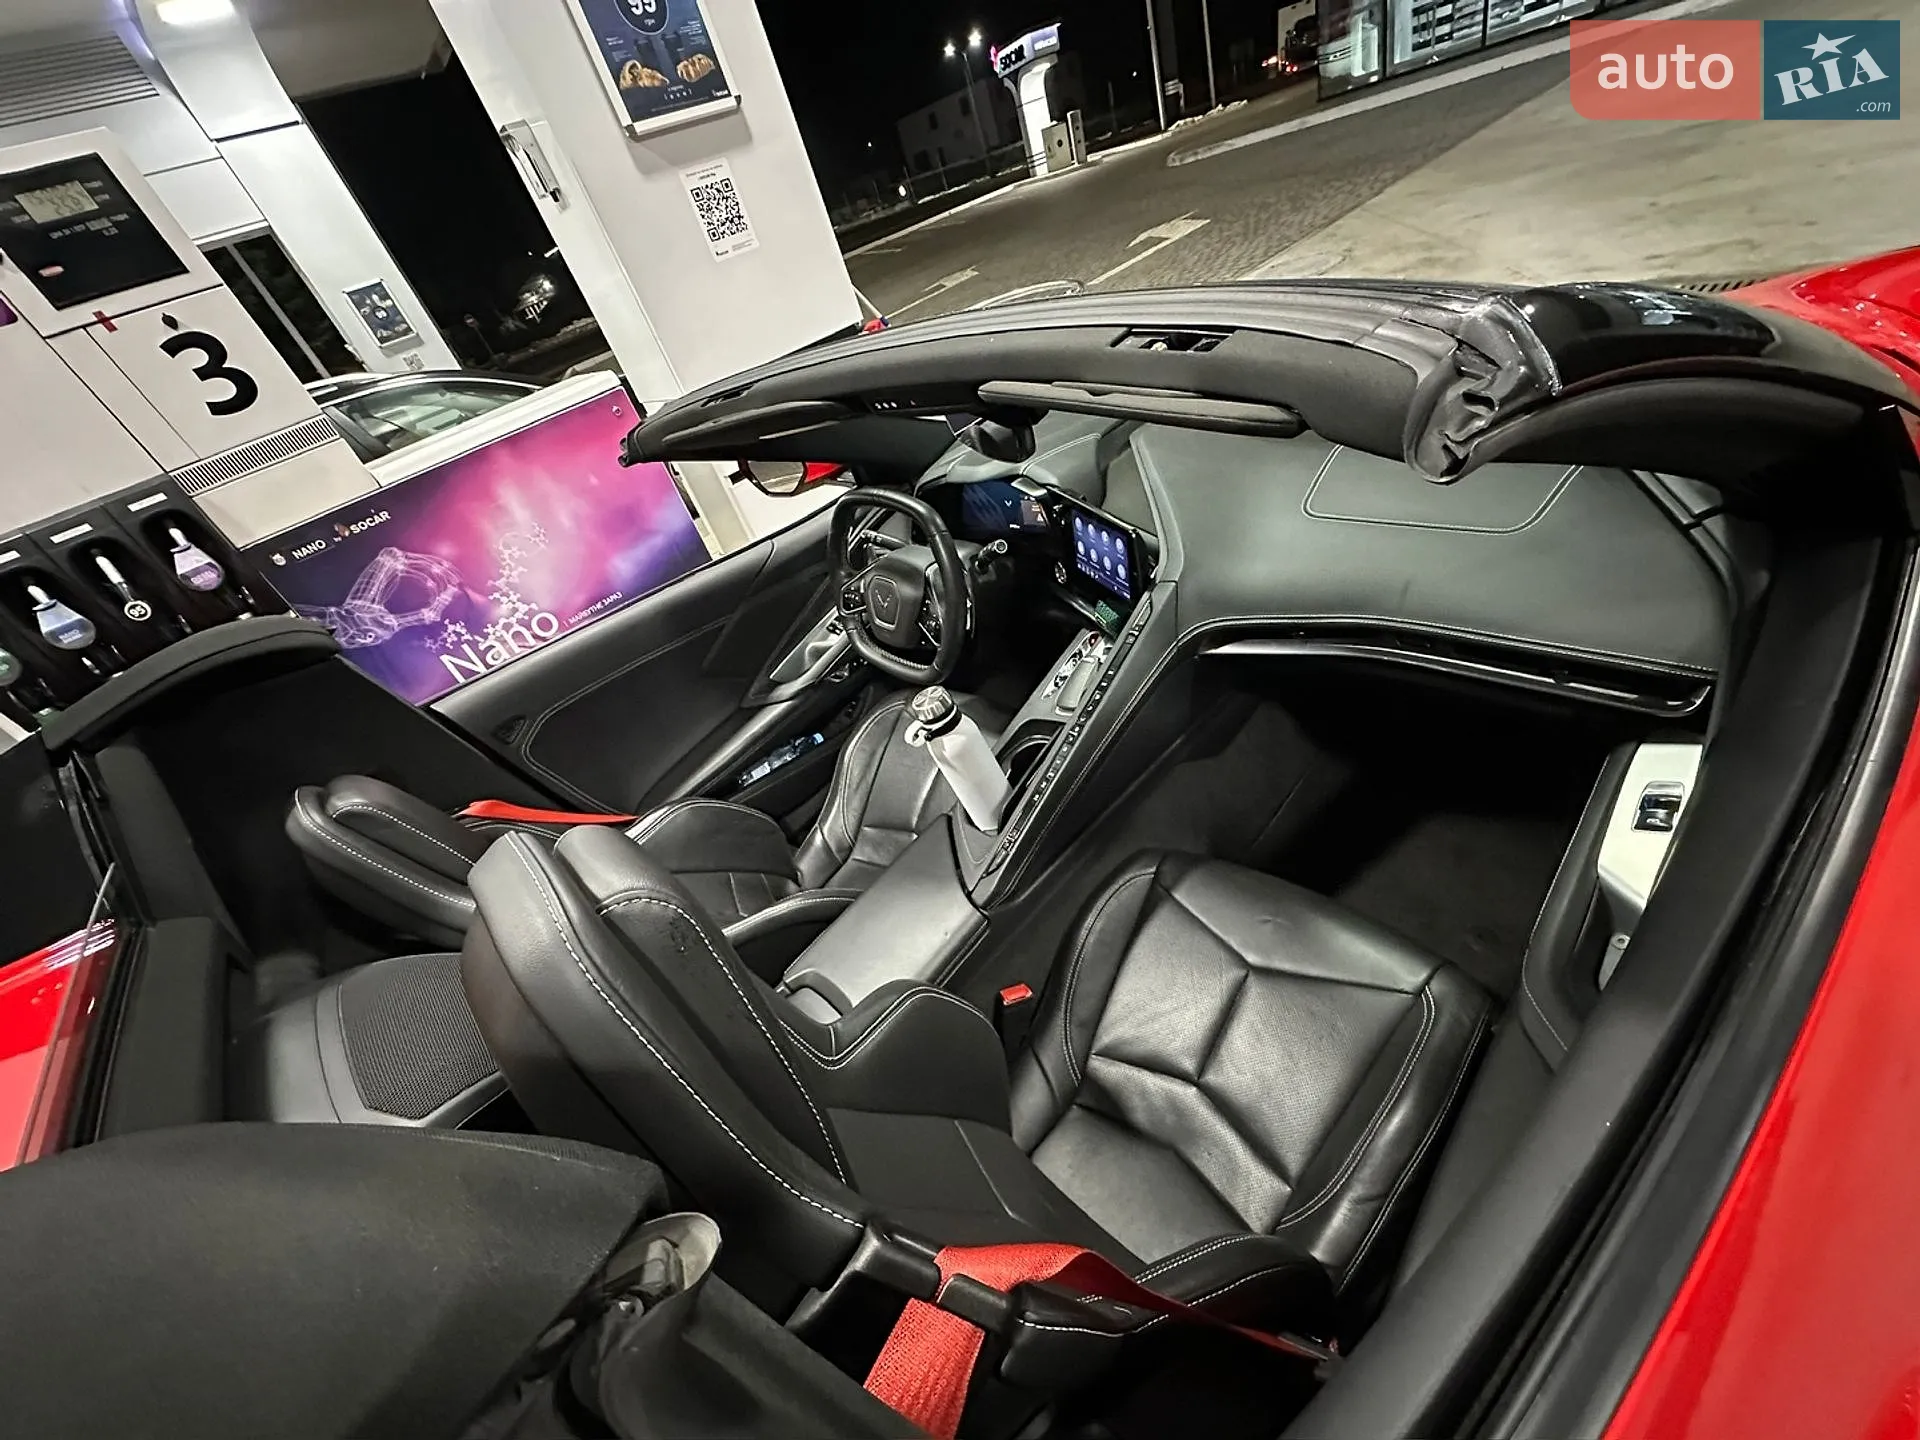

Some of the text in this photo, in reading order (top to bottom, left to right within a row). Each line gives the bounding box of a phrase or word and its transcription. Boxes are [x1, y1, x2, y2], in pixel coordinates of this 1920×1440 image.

[159, 331, 259, 416] 3
[291, 539, 327, 560] NANO
[350, 510, 392, 534] SOCAR
[129, 605, 147, 618] 95
[439, 612, 559, 684] Nano
